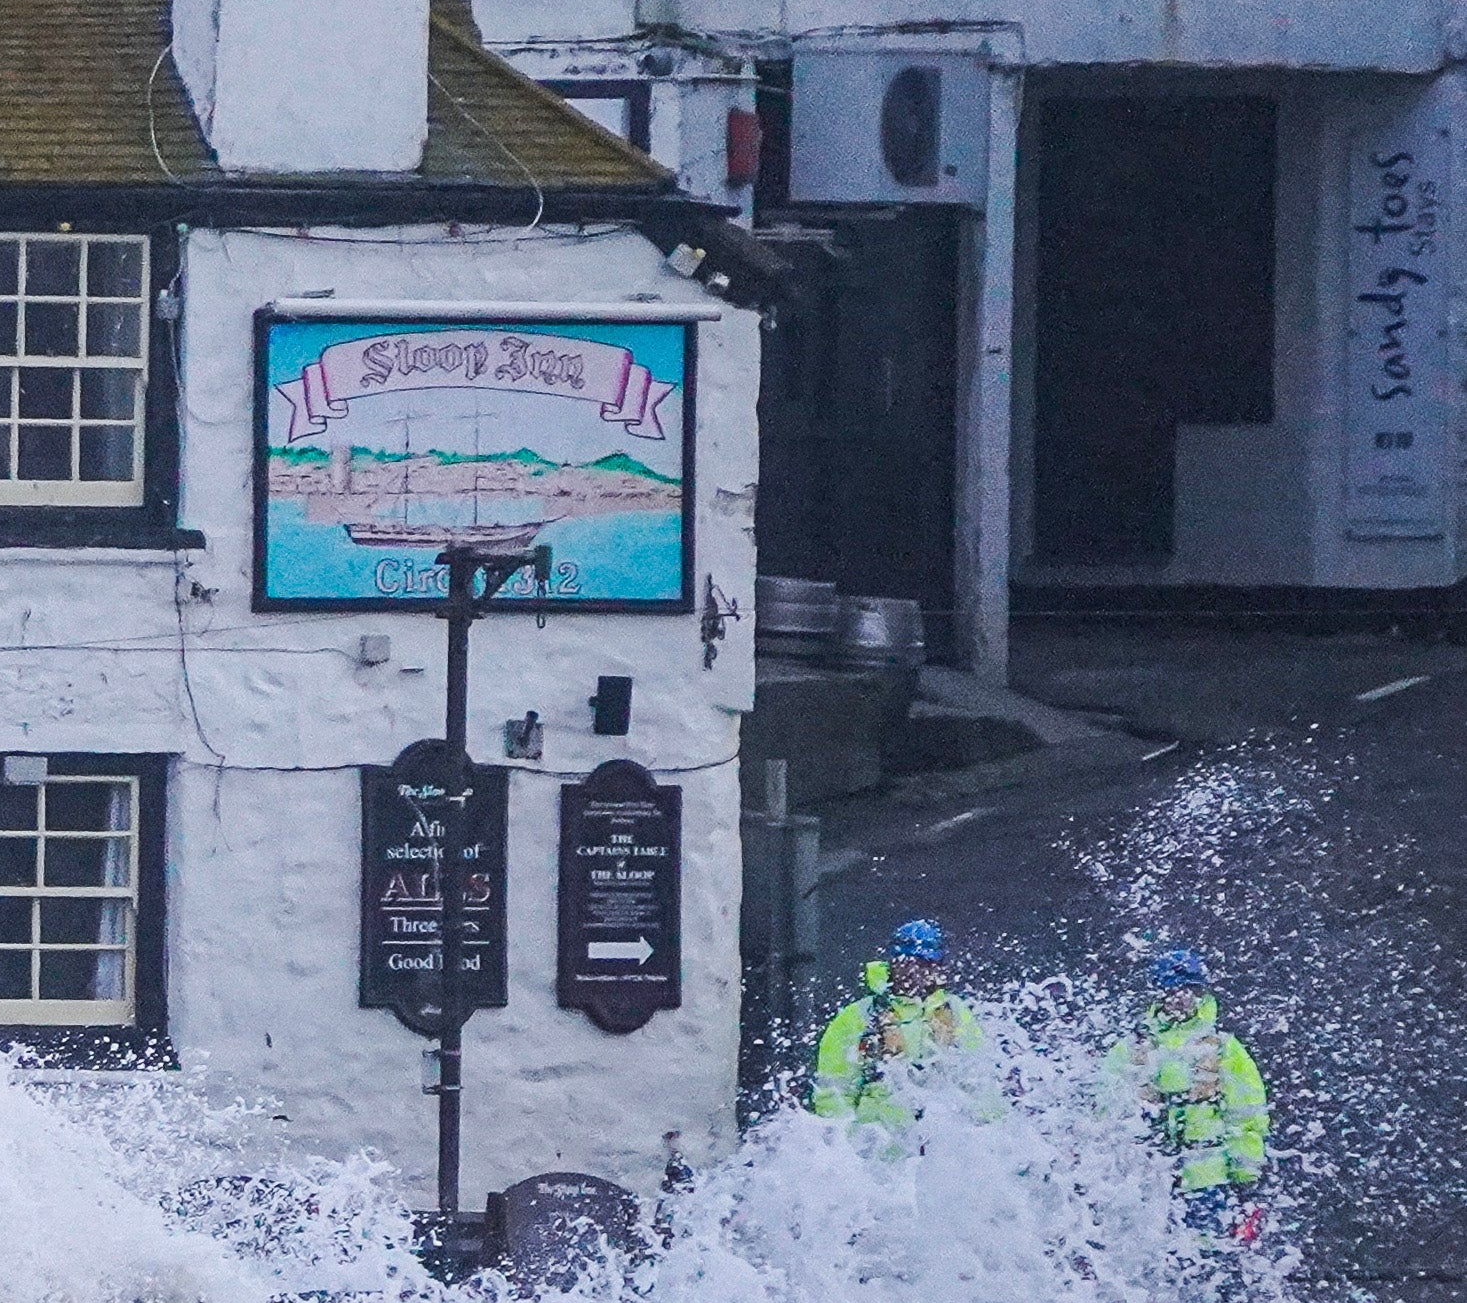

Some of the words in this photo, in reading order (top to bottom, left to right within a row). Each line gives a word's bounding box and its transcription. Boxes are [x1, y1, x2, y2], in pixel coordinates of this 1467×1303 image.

[1352, 150, 1416, 246] toes
[1355, 267, 1428, 402] sandy
[360, 339, 489, 388] Sloop
[494, 335, 585, 390] Inn
[374, 557, 452, 594] Circ
[410, 821, 425, 837] A
[463, 842, 482, 860] of
[380, 873, 491, 902] ALS
[389, 916, 439, 933] Three
[388, 953, 434, 971] Good
